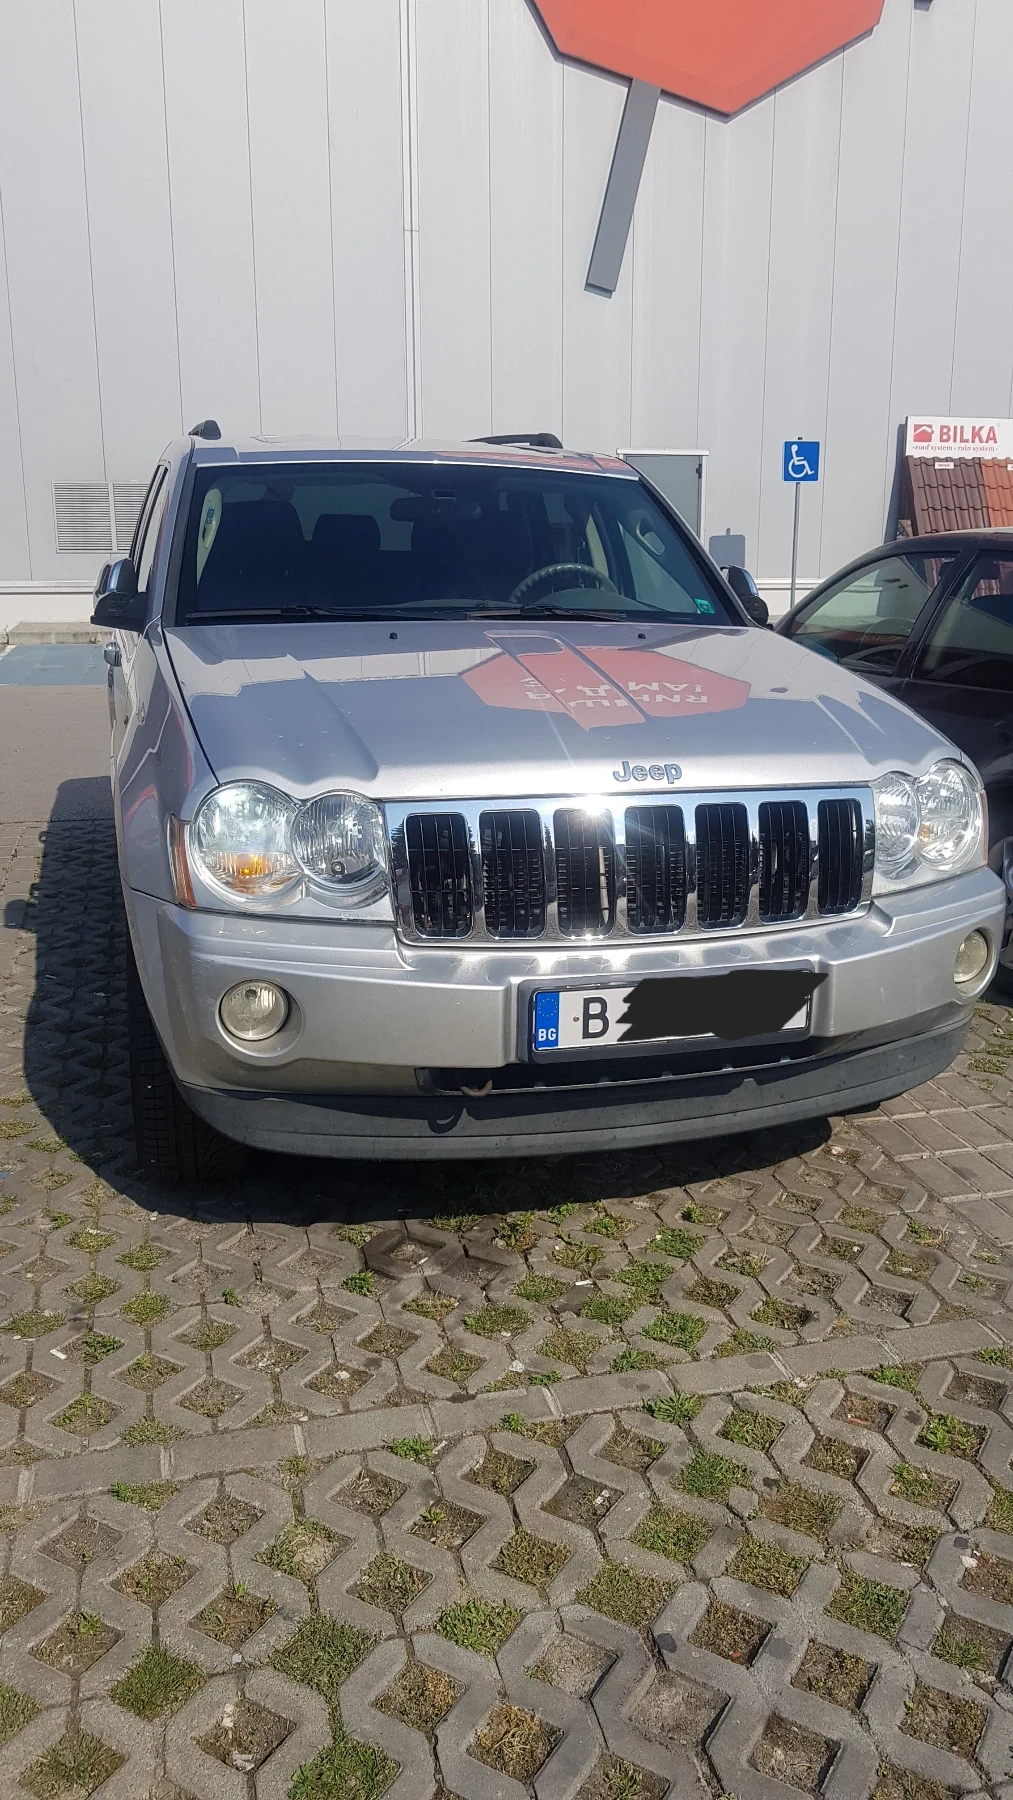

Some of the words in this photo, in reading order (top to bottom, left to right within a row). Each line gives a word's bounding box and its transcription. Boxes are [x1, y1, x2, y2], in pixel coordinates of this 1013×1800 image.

[940, 425, 998, 443] BILKA
[612, 760, 683, 784] Jeep
[537, 1028, 557, 1042] BG
